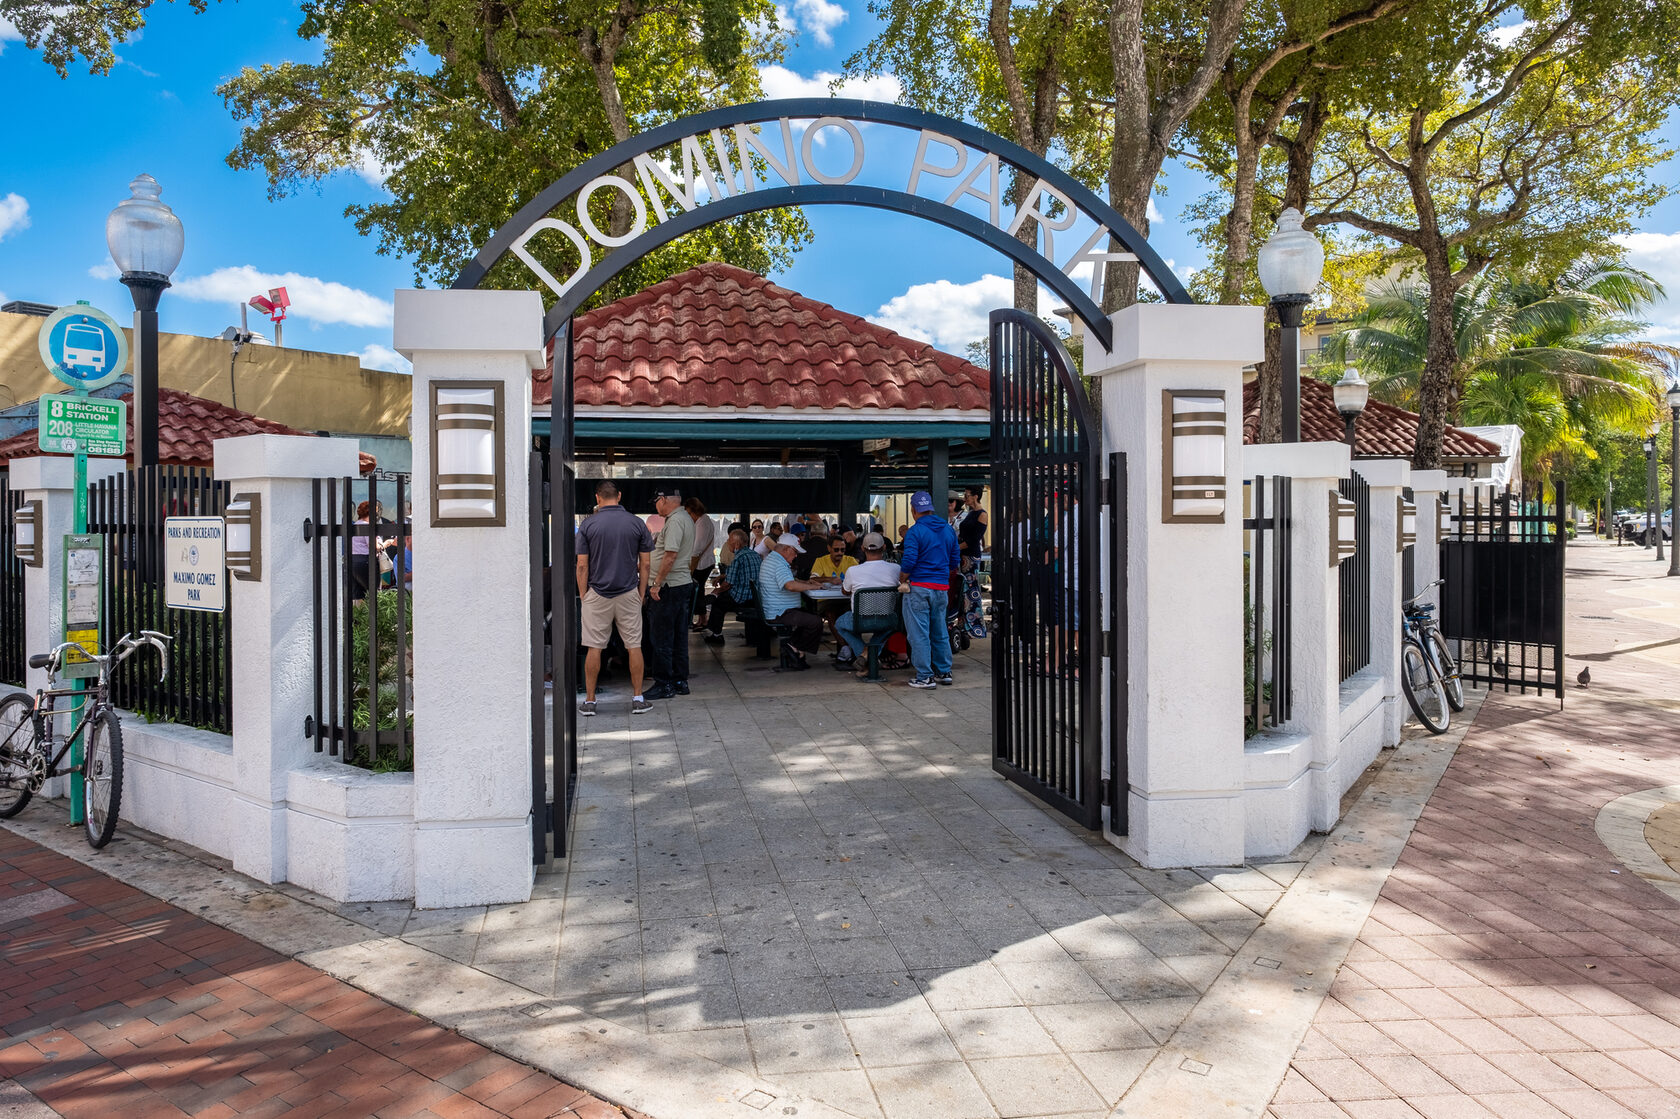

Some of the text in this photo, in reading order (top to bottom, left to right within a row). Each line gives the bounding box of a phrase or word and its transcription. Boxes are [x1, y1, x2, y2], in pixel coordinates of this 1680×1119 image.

[509, 116, 1141, 303] DOMINO PARK
[51, 401, 63, 417] 8
[66, 402, 117, 414] BRICKELL
[66, 411, 109, 421] STATION
[48, 420, 73, 436] 208
[168, 527, 221, 539] PARKS AND RECREATION
[173, 571, 216, 586] MAXIMO GOMEZ
[187, 588, 201, 601] PARK
